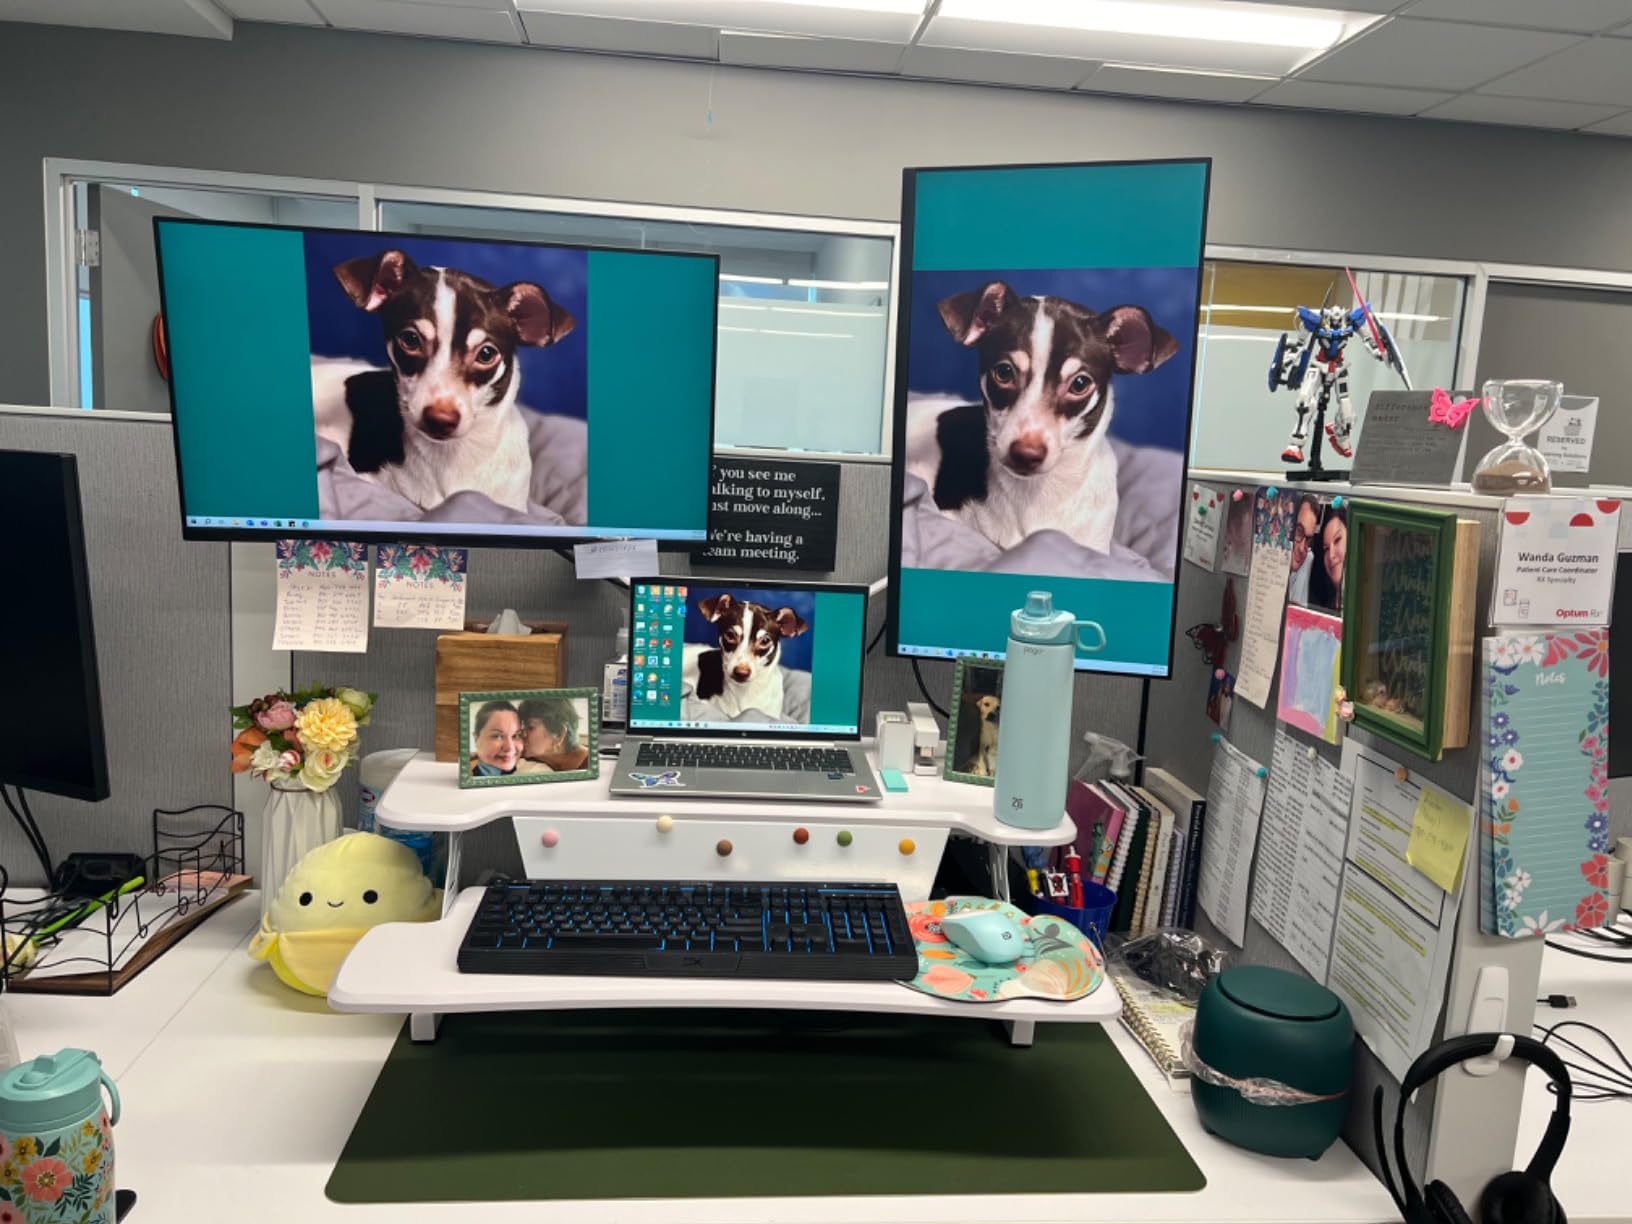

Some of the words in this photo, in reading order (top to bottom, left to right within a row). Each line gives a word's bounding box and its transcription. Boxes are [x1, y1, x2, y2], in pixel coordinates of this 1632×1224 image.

[1547, 436, 1586, 444] RESERVED
[719, 468, 745, 482] you
[748, 470, 771, 481] see
[773, 471, 797, 482] me
[711, 483, 754, 501] lking
[756, 487, 770, 498] to
[773, 487, 826, 503] myself.
[733, 503, 770, 514] move
[772, 501, 822, 520] along...
[745, 529, 793, 548] having
[795, 535, 804, 545] a
[740, 547, 800, 564] meeting.
[1518, 551, 1555, 563] Wanda
[1557, 552, 1600, 563] Guzman
[308, 571, 337, 579] NOTES
[1542, 566, 1557, 574] Care
[1558, 566, 1599, 574] Coordinator
[406, 581, 435, 589] NOTES
[1547, 576, 1576, 585] Specialty
[1556, 608, 1589, 619] Optum
[1535, 671, 1566, 686] Notes
